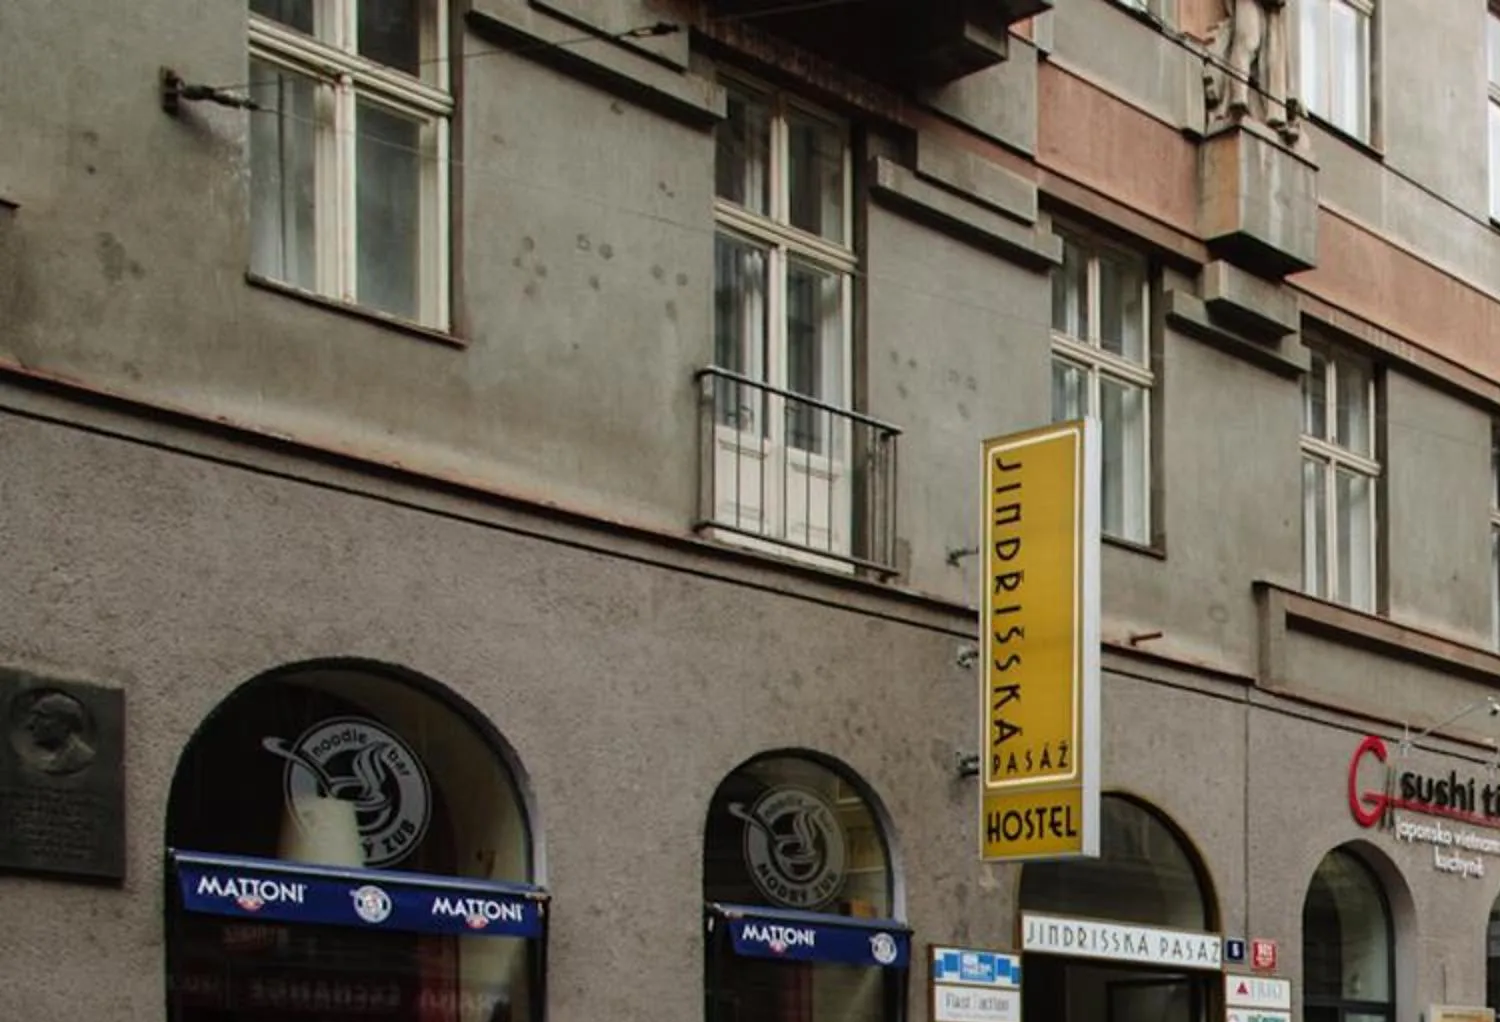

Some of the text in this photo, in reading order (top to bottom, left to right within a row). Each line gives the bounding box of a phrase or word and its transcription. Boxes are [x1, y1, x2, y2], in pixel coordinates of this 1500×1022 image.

[312, 727, 411, 776] noodle bar
[991, 741, 1071, 776] PASÁŽ
[1399, 768, 1476, 815] sushi
[381, 818, 416, 855] ZUB
[986, 804, 1078, 844] HOSTEL
[197, 875, 304, 905] MATTONI
[432, 896, 523, 923] MATTONI
[741, 923, 816, 946] MATTONI
